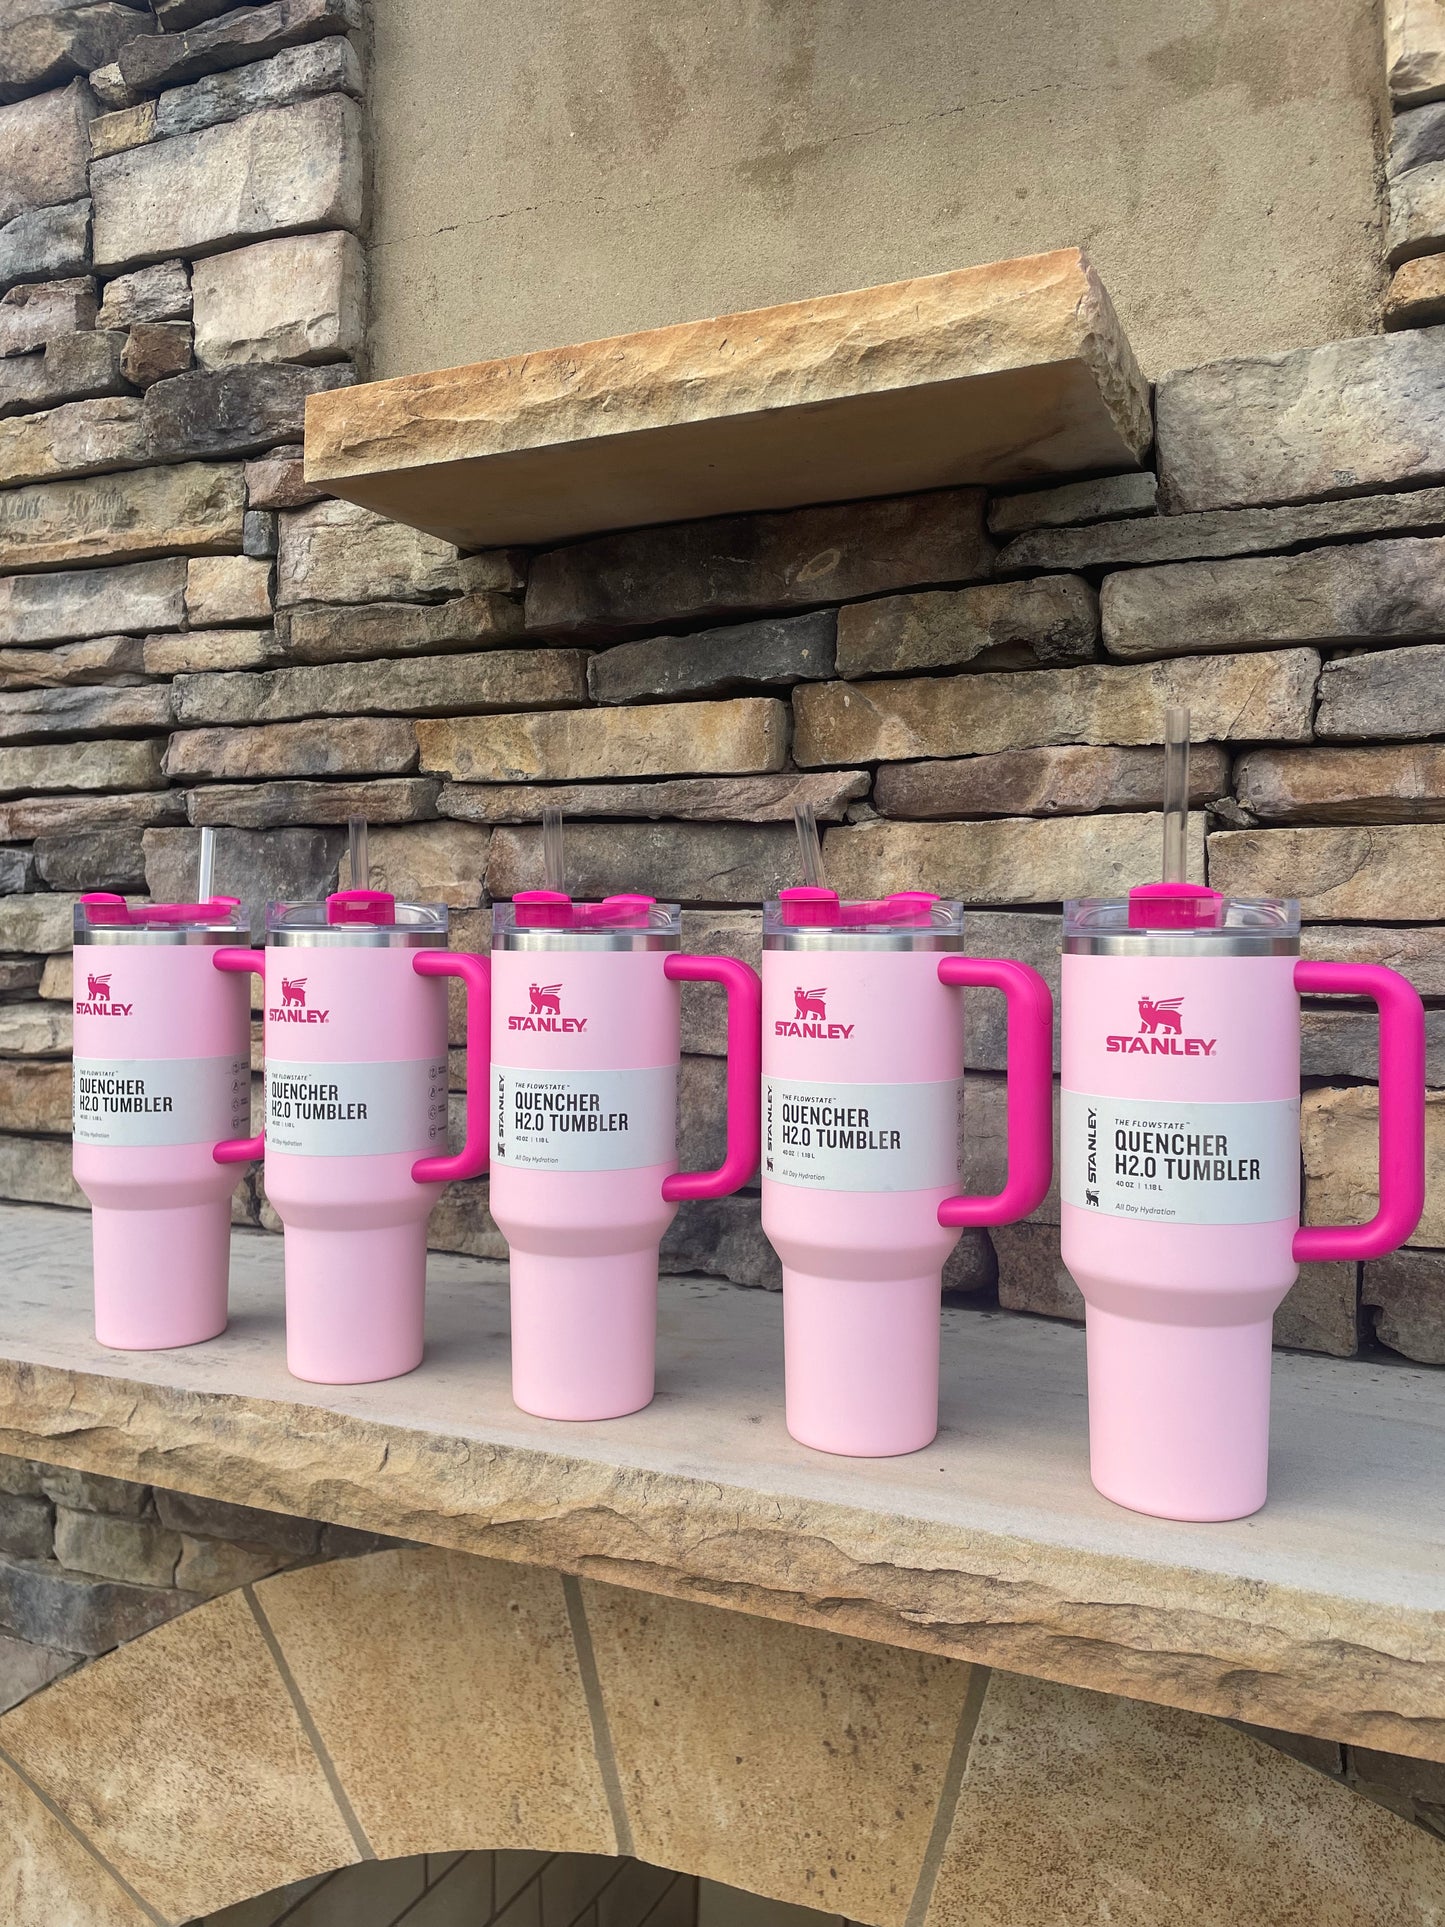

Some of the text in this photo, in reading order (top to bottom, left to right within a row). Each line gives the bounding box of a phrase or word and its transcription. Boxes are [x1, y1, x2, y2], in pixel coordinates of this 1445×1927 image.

[76, 1002, 133, 1016] STANLEY
[269, 1008, 330, 1023] STANLEY
[508, 1016, 588, 1033] STANLEY
[775, 1021, 855, 1039] STANLEY
[1106, 1035, 1217, 1056] STANLEY
[80, 1077, 145, 1095] QUENCHER
[271, 1081, 338, 1101] QUENCHER
[80, 1094, 173, 1113] H2.0 TUMBLER
[515, 1091, 600, 1112] QUENCHER
[793, 1095, 832, 1104] FLOWSTATE
[271, 1100, 367, 1120] H2.0 TUMBLER
[782, 1103, 869, 1128] QUENCHER
[515, 1111, 629, 1132] H2.0 TUMBLER
[1115, 1118, 1185, 1130] THE FLOWSTATE
[782, 1124, 901, 1150] H2.0 TUMBLER
[1087, 1107, 1097, 1184] STANLEY
[1115, 1129, 1228, 1156] QUENCHER
[798, 1172, 825, 1181] Hydration
[1115, 1153, 1260, 1181] H2.0 TUMBLER
[1125, 1181, 1134, 1189] OZ
[1125, 1204, 1139, 1214] Day
[1140, 1206, 1176, 1216] Hydration
